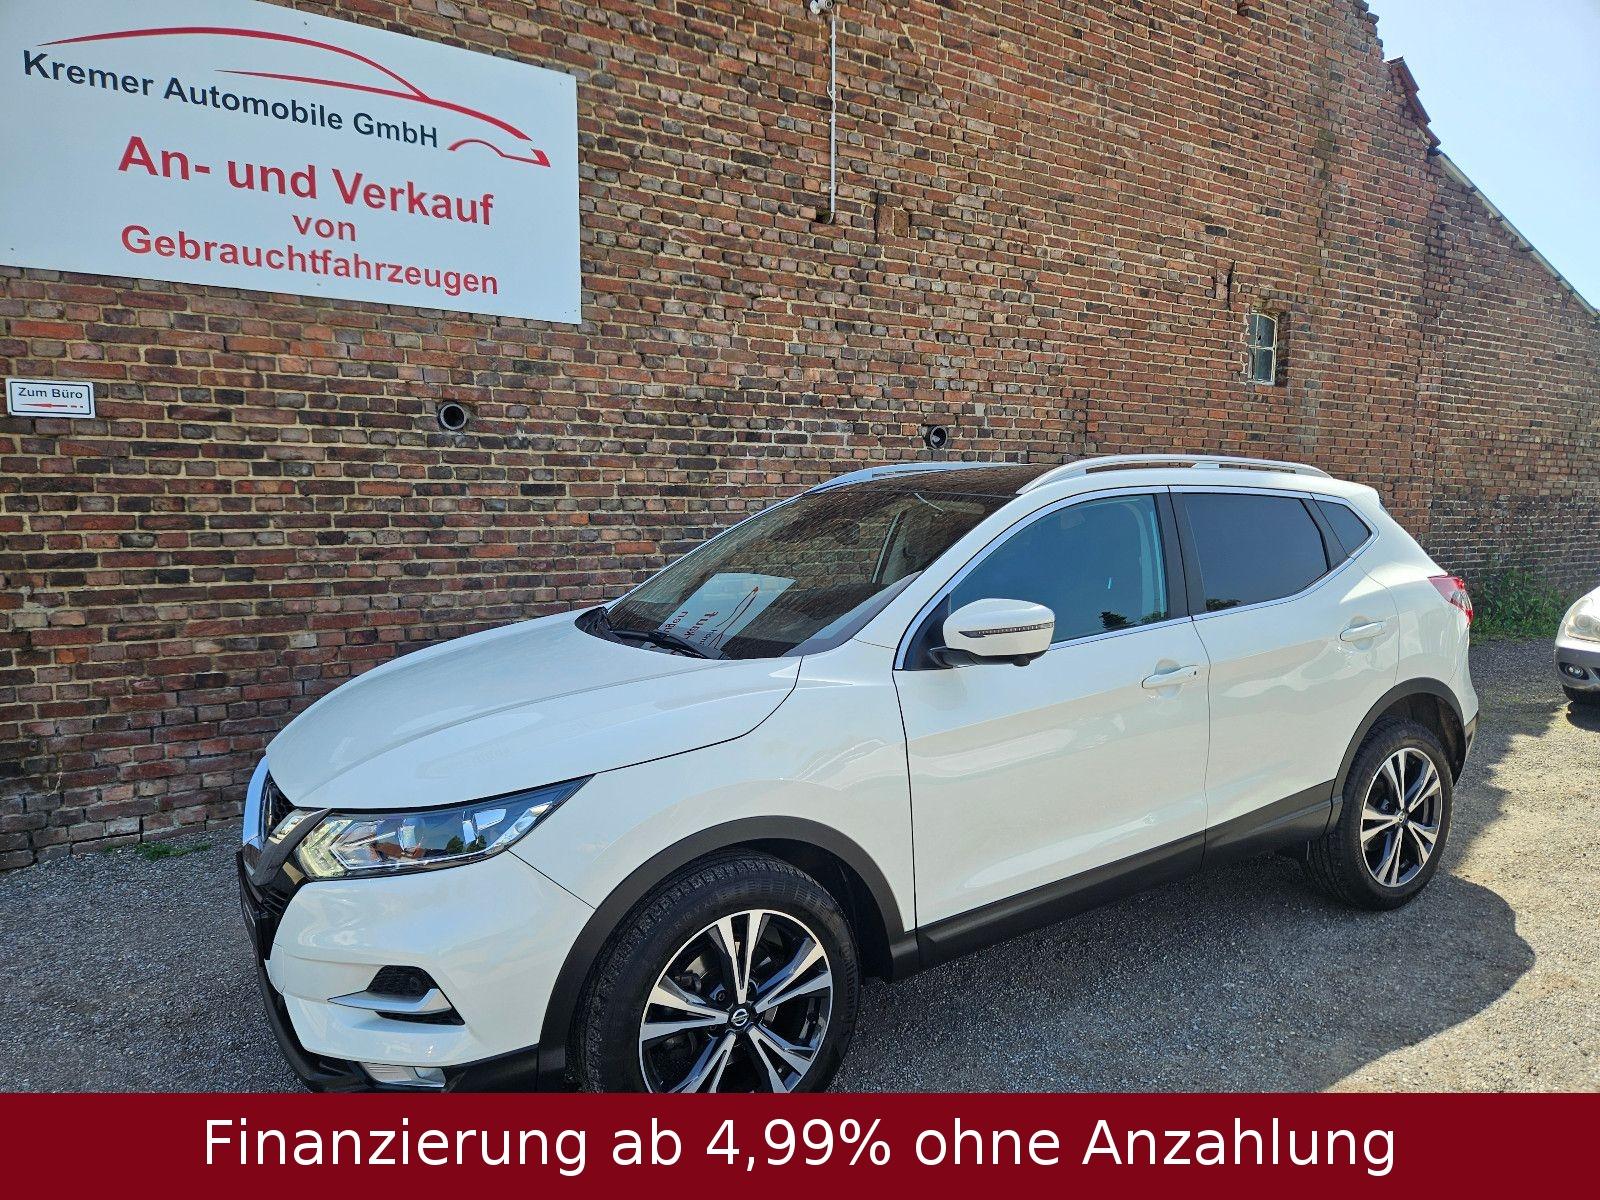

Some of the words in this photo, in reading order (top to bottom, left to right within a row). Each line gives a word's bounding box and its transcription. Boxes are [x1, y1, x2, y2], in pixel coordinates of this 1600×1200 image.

[23, 49, 154, 97] Kremer
[164, 78, 343, 130] Automobile
[353, 112, 438, 148] GmbH
[118, 135, 211, 181] An-
[227, 160, 317, 199] und
[332, 168, 494, 225] Verkauf
[121, 224, 499, 297] Gebrauchtfahrzeugen
[293, 215, 356, 241] von
[18, 386, 48, 398] Zum
[51, 388, 83, 399] Büro
